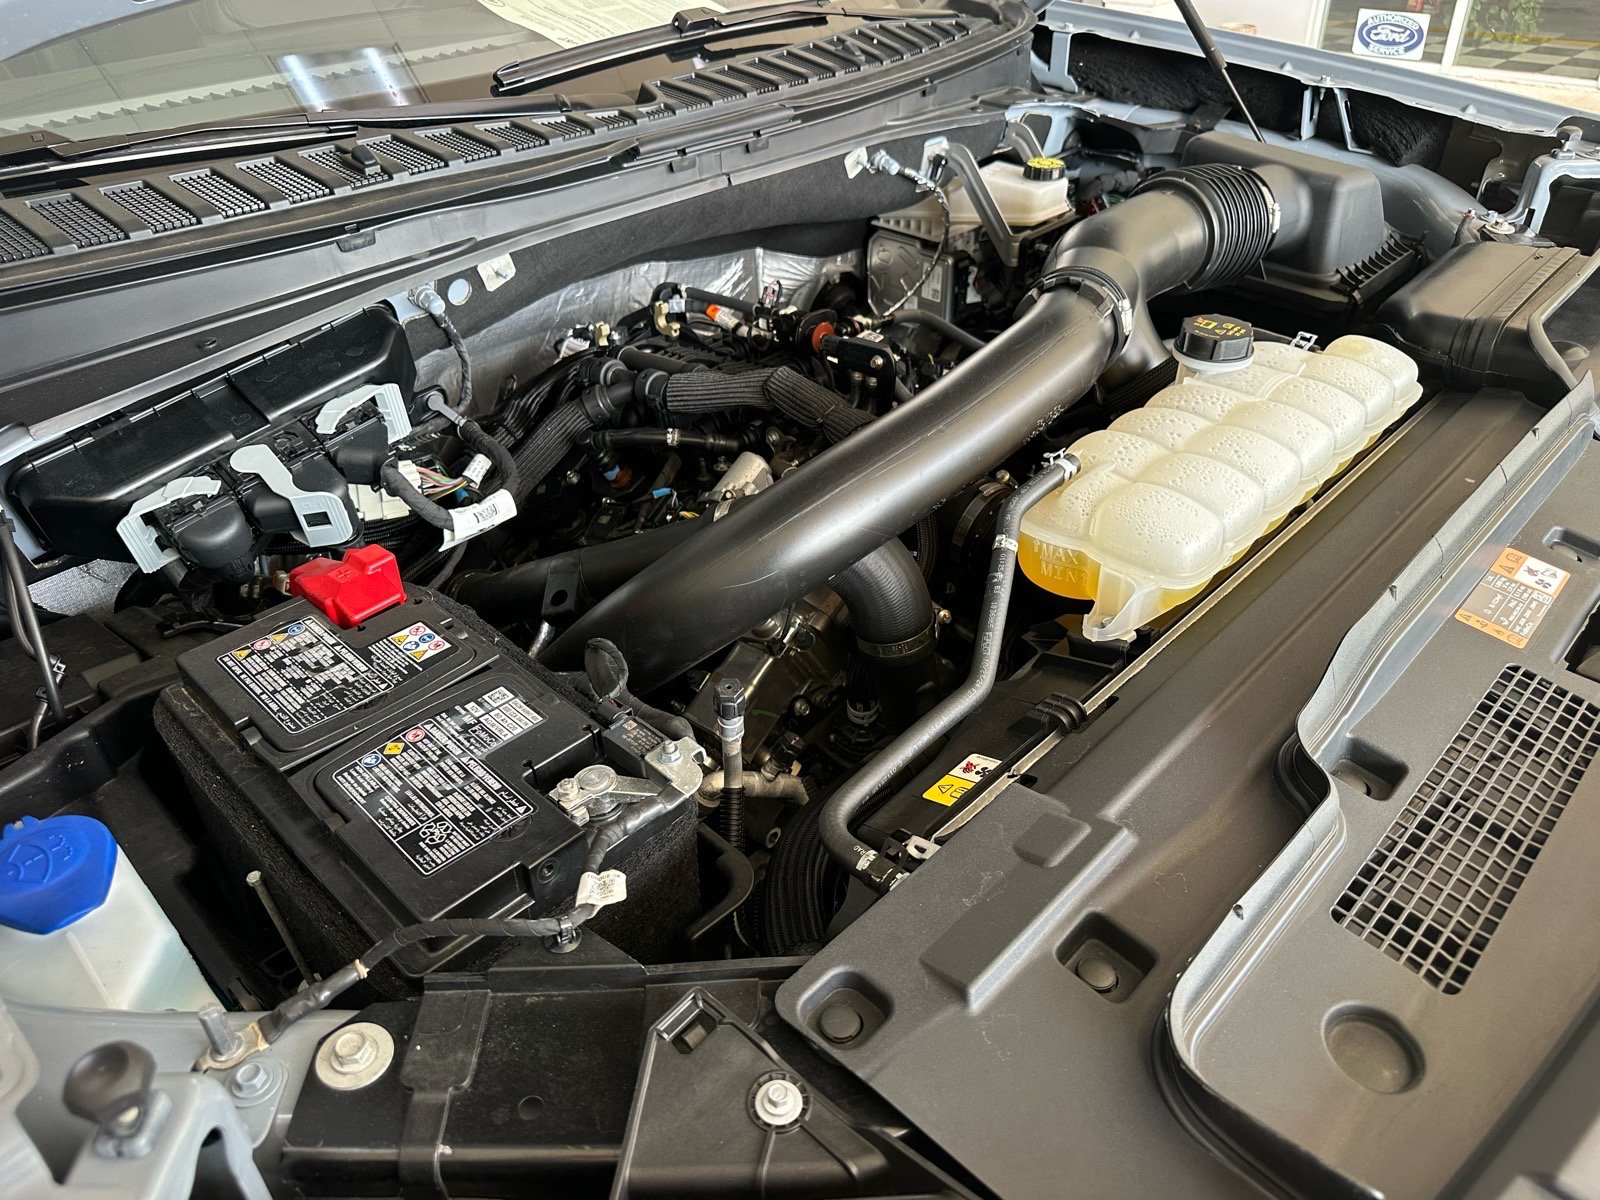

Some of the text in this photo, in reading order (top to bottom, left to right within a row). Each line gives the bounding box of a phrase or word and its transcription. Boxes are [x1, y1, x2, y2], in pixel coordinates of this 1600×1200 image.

[1367, 13, 1420, 31] AUTHORIZED
[1370, 24, 1411, 43] Ford
[1367, 43, 1406, 56] SERVICE
[1041, 543, 1079, 565] MAX
[1041, 560, 1079, 584] MIN
[472, 726, 498, 748] FoMoCo
[853, 844, 867, 856] RAD
